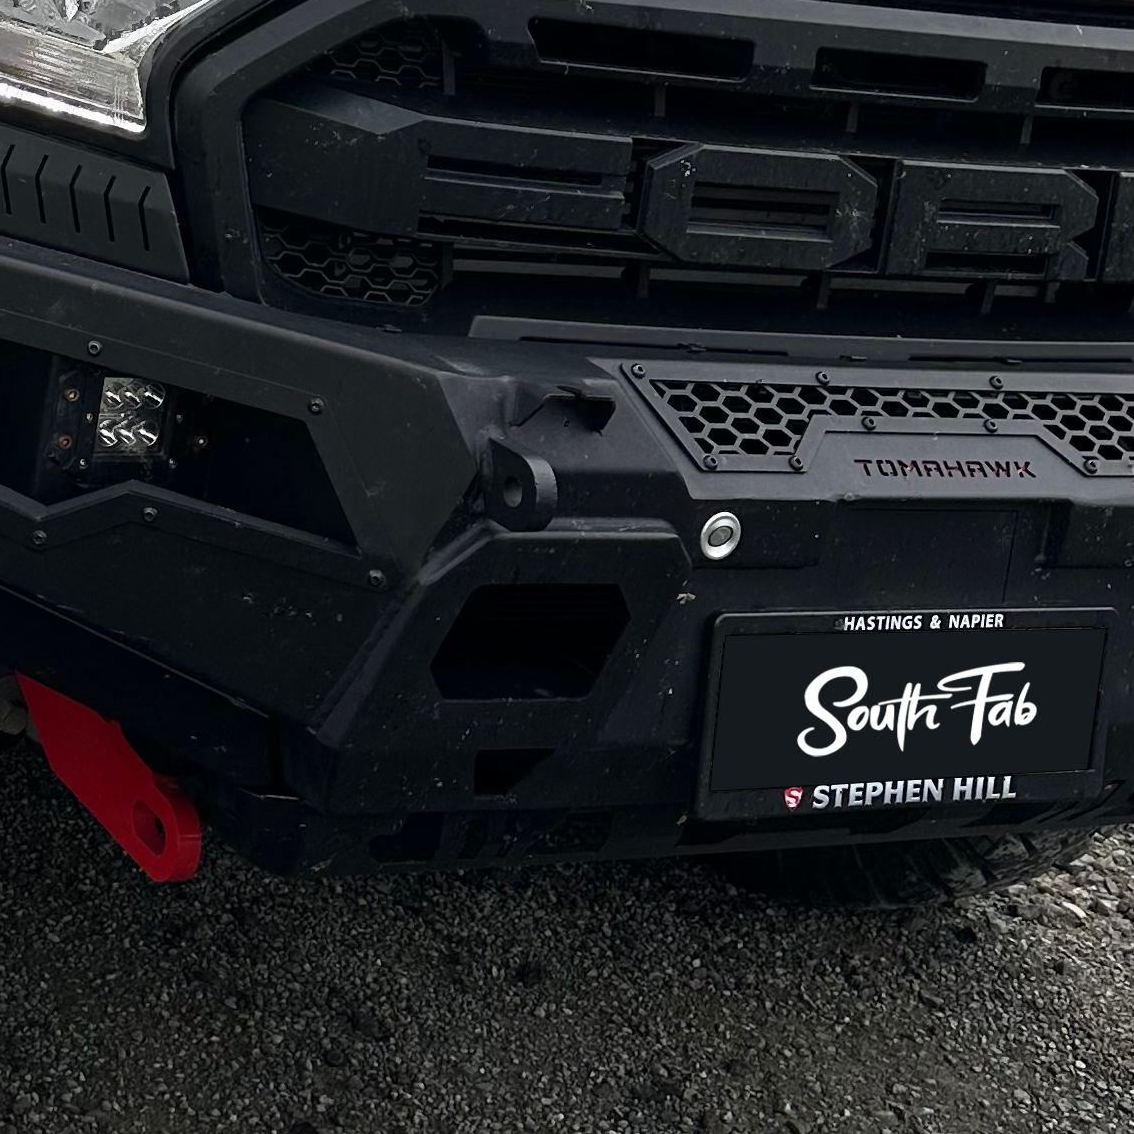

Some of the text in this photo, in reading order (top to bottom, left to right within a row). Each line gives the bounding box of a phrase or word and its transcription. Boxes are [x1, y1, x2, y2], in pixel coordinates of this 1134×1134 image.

[854, 459, 1037, 478] TOMAHAWK
[843, 613, 1004, 631] HASTINGS & NAPIER
[812, 775, 1016, 809] STEPHEN HILL
